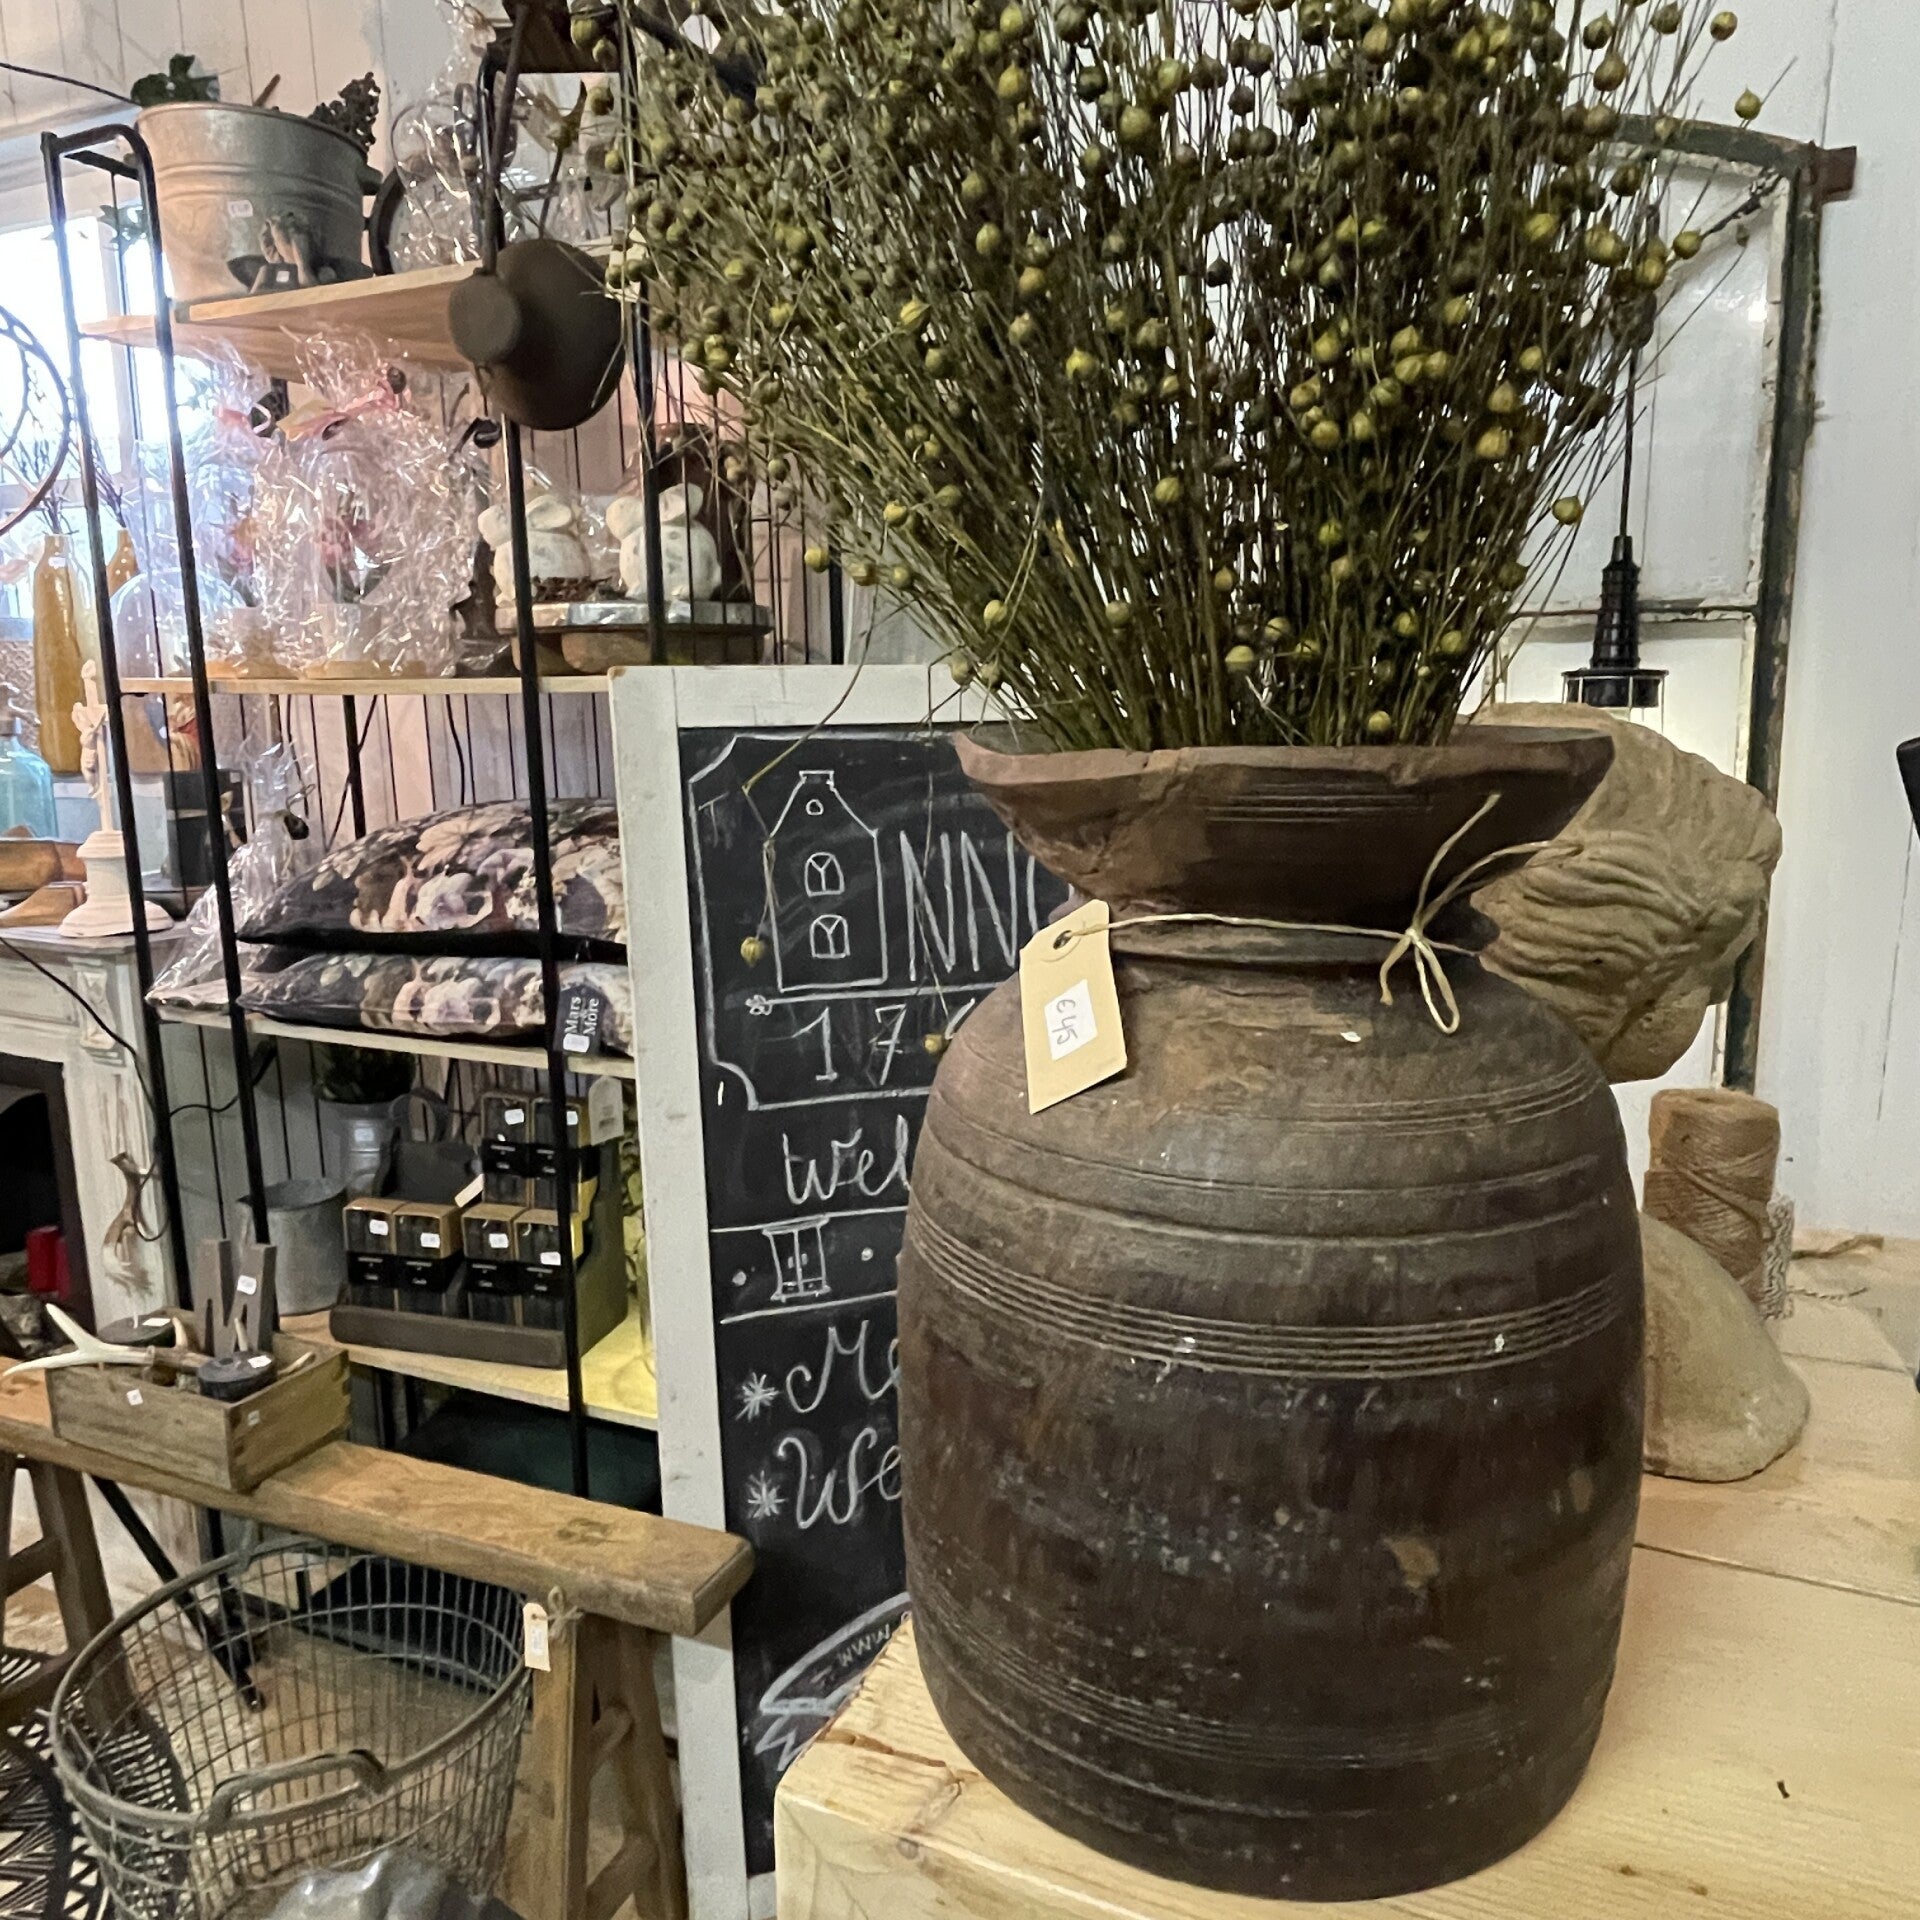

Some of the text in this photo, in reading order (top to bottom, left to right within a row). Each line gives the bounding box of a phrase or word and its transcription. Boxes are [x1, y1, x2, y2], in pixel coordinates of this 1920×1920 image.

[563, 996, 582, 1034] Mars
[582, 998, 600, 1036] More
[1051, 999, 1079, 1045] €45
